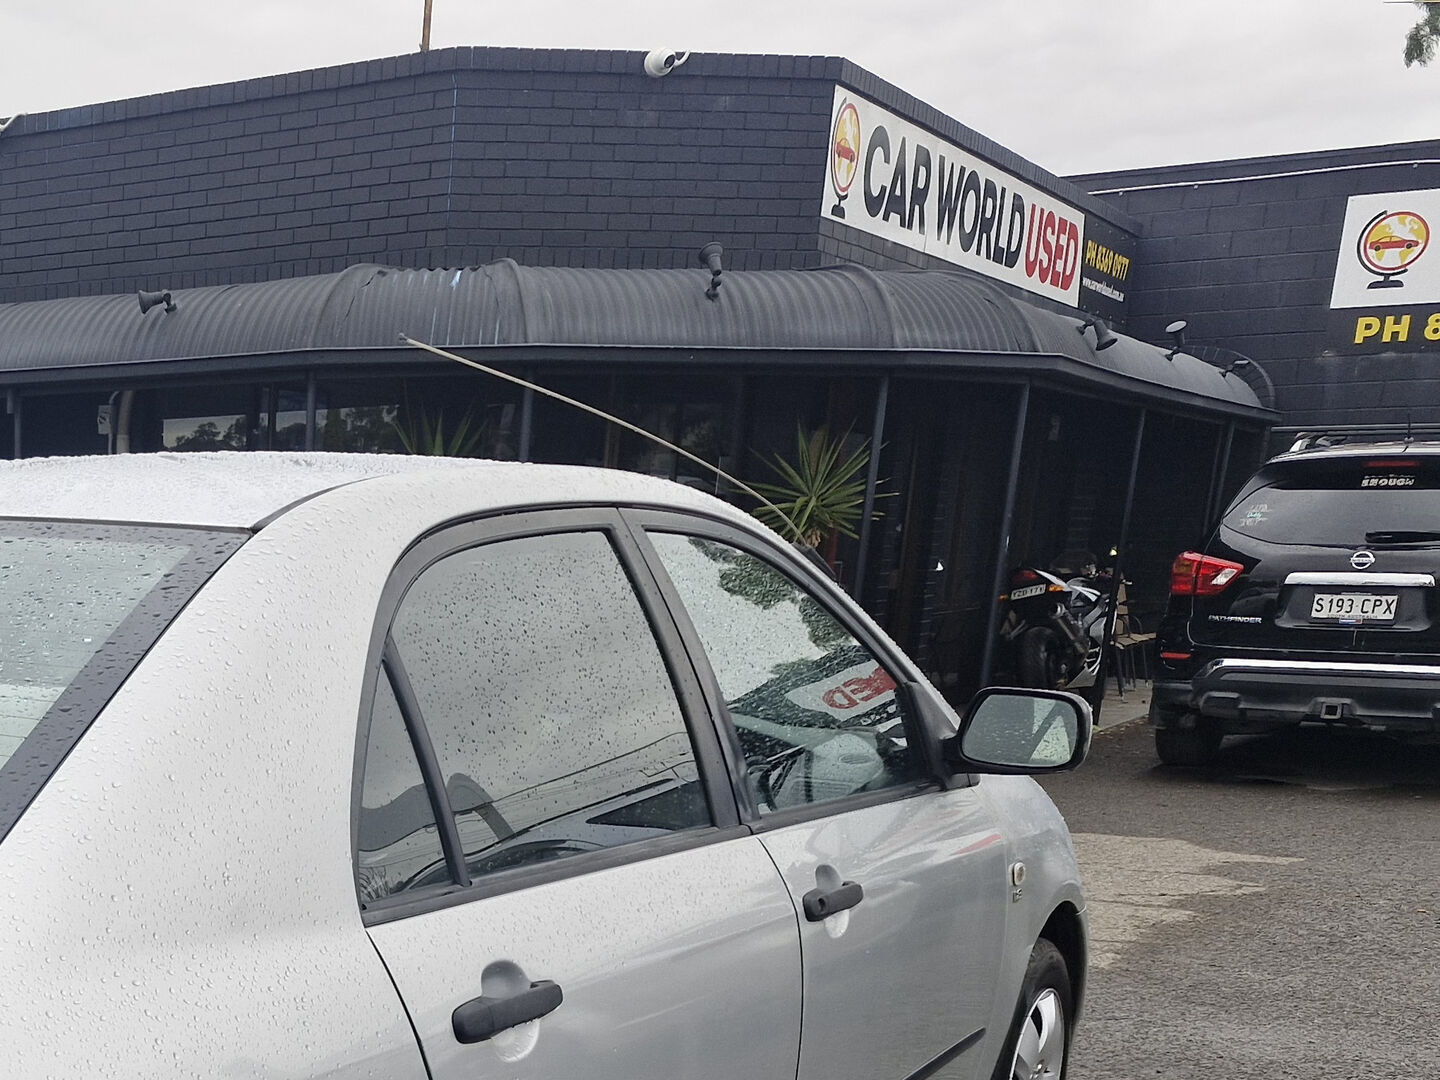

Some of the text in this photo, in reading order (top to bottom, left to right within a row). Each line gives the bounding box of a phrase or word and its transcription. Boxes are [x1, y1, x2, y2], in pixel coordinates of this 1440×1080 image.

[863, 125, 1080, 292] CAR WORLD USED
[1085, 240, 1097, 267] PH
[1354, 314, 1412, 344] PH
